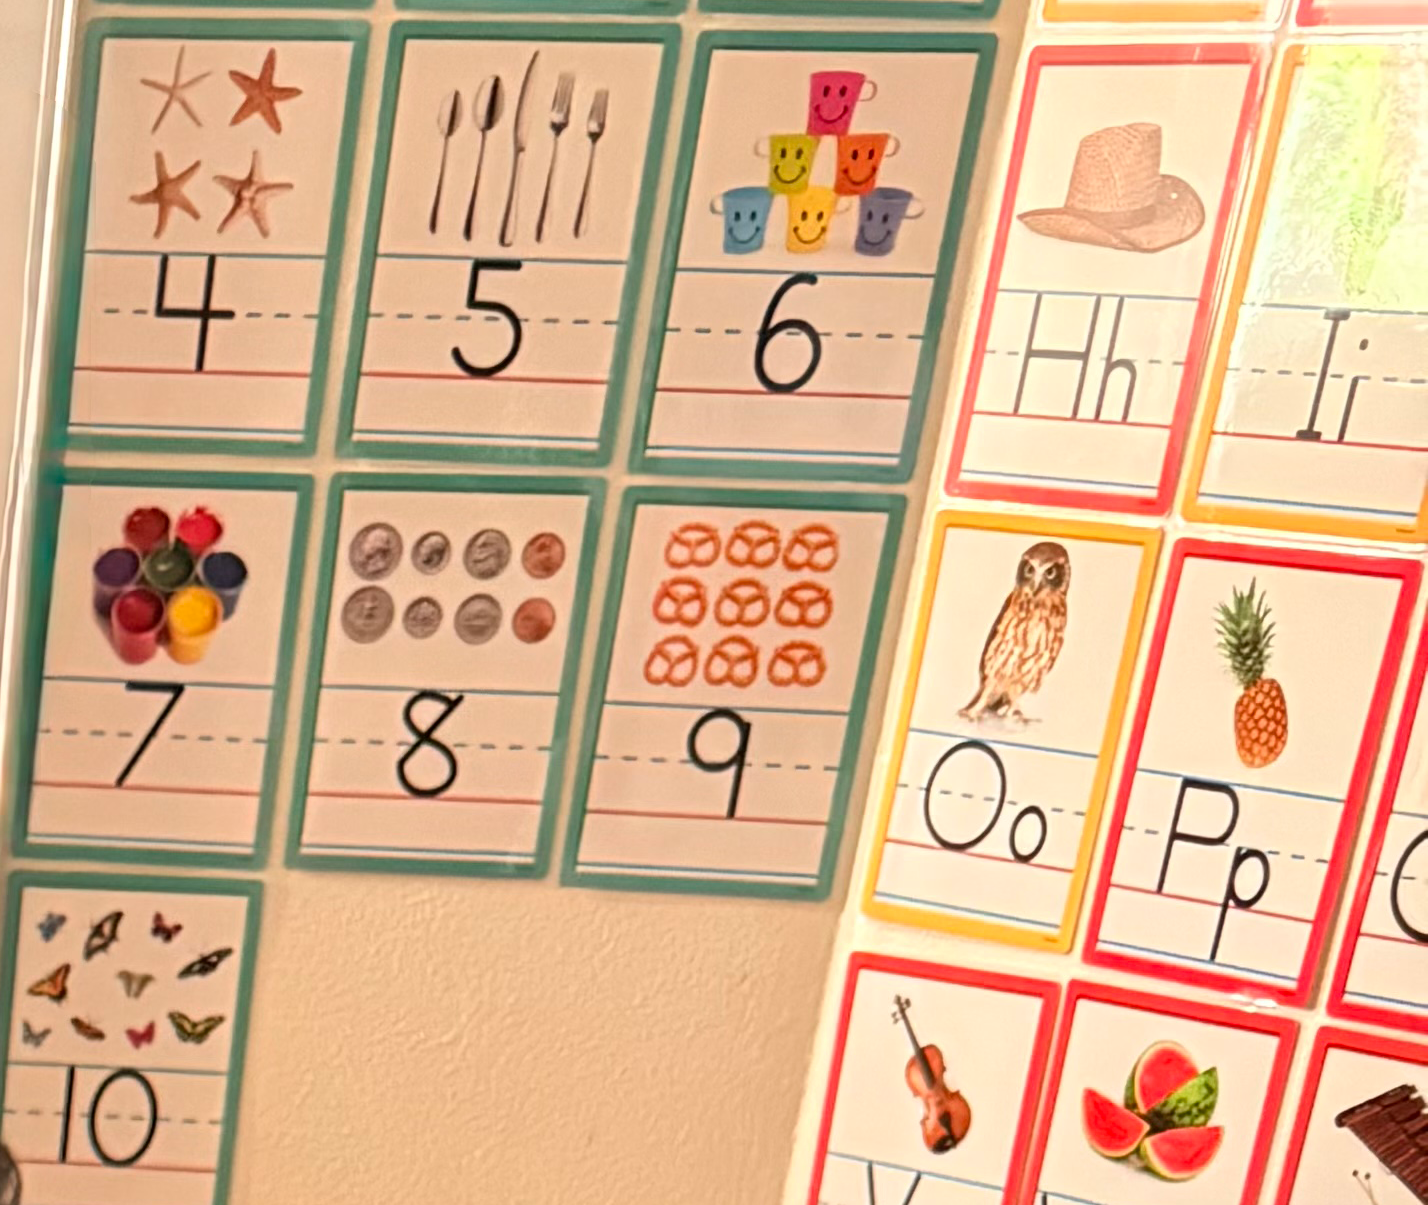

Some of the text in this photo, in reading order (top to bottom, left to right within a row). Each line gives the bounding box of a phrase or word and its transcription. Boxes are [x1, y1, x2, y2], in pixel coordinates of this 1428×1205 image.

[154, 254, 235, 372] 4
[451, 258, 523, 378] 5
[753, 273, 823, 394] 6
[1013, 292, 1138, 423] Hh
[1296, 309, 1371, 443] Ii
[115, 681, 185, 787] 7
[396, 689, 465, 797] 8
[687, 707, 752, 819] 9
[923, 739, 1048, 864] Oo
[1156, 777, 1271, 963] Pp
[58, 1064, 158, 1168] 10
